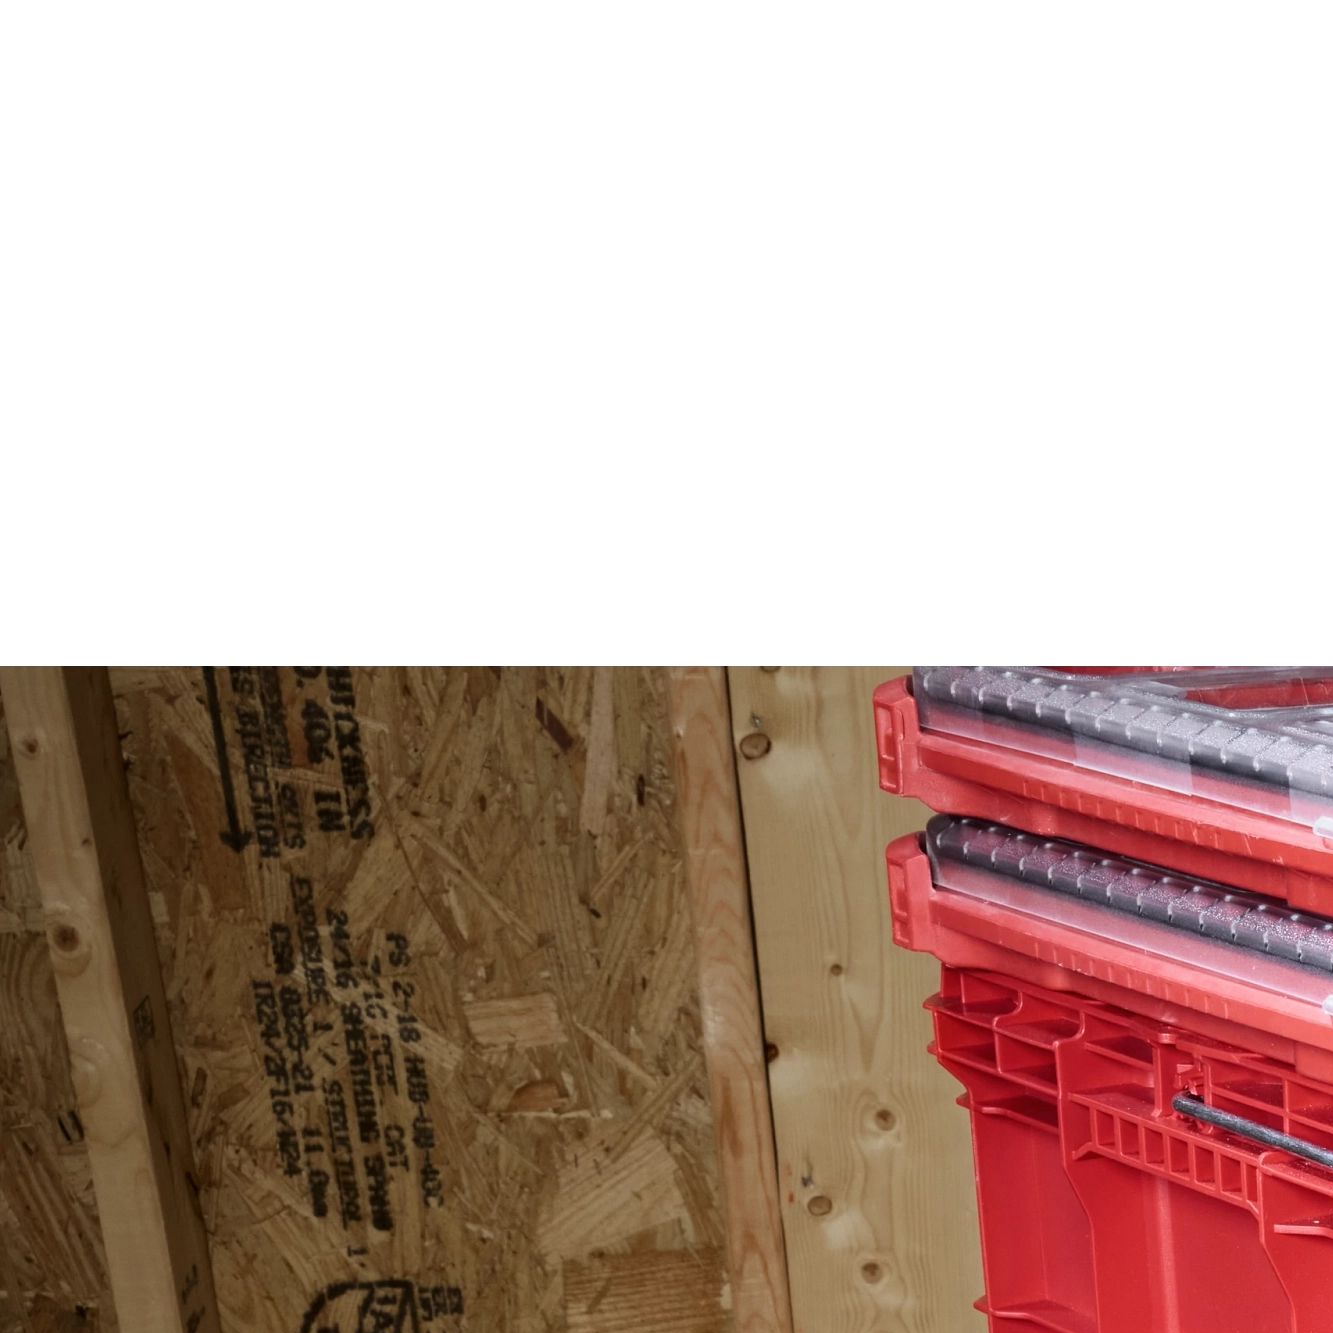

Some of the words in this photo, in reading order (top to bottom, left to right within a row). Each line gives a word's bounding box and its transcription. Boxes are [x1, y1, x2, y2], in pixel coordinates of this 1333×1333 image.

[269, 920, 296, 974] CSA
[325, 906, 358, 990] 24/16
[385, 931, 410, 968] PS
[391, 979, 421, 1044] 2-18
[291, 875, 330, 1006] EXPOSURE
[322, 1077, 364, 1230] STRUCTURAL
[341, 1001, 380, 1142] SHEATHING
